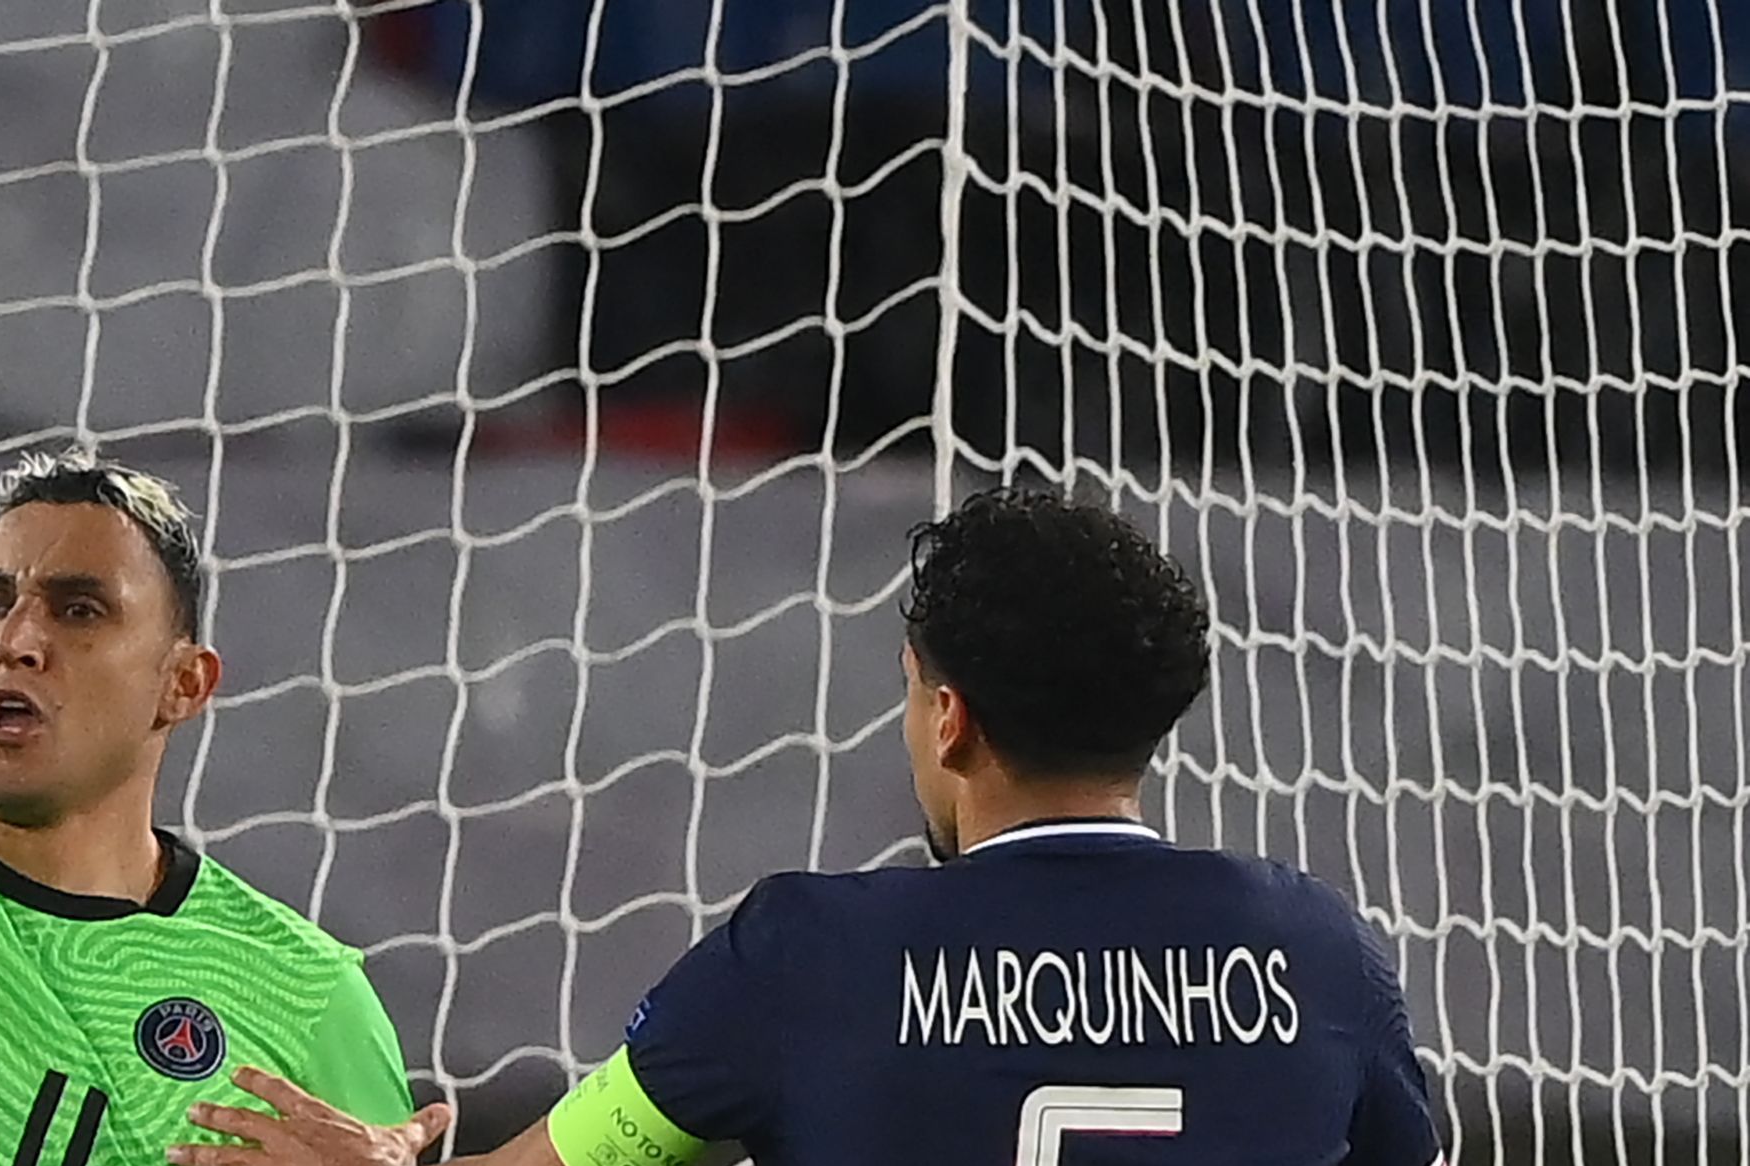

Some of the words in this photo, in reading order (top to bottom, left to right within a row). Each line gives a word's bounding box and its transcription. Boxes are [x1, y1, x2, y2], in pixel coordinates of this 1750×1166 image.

[898, 945, 1300, 1047] MARQUINHOS
[610, 1106, 638, 1138] NO
[636, 1135, 662, 1159] TO
